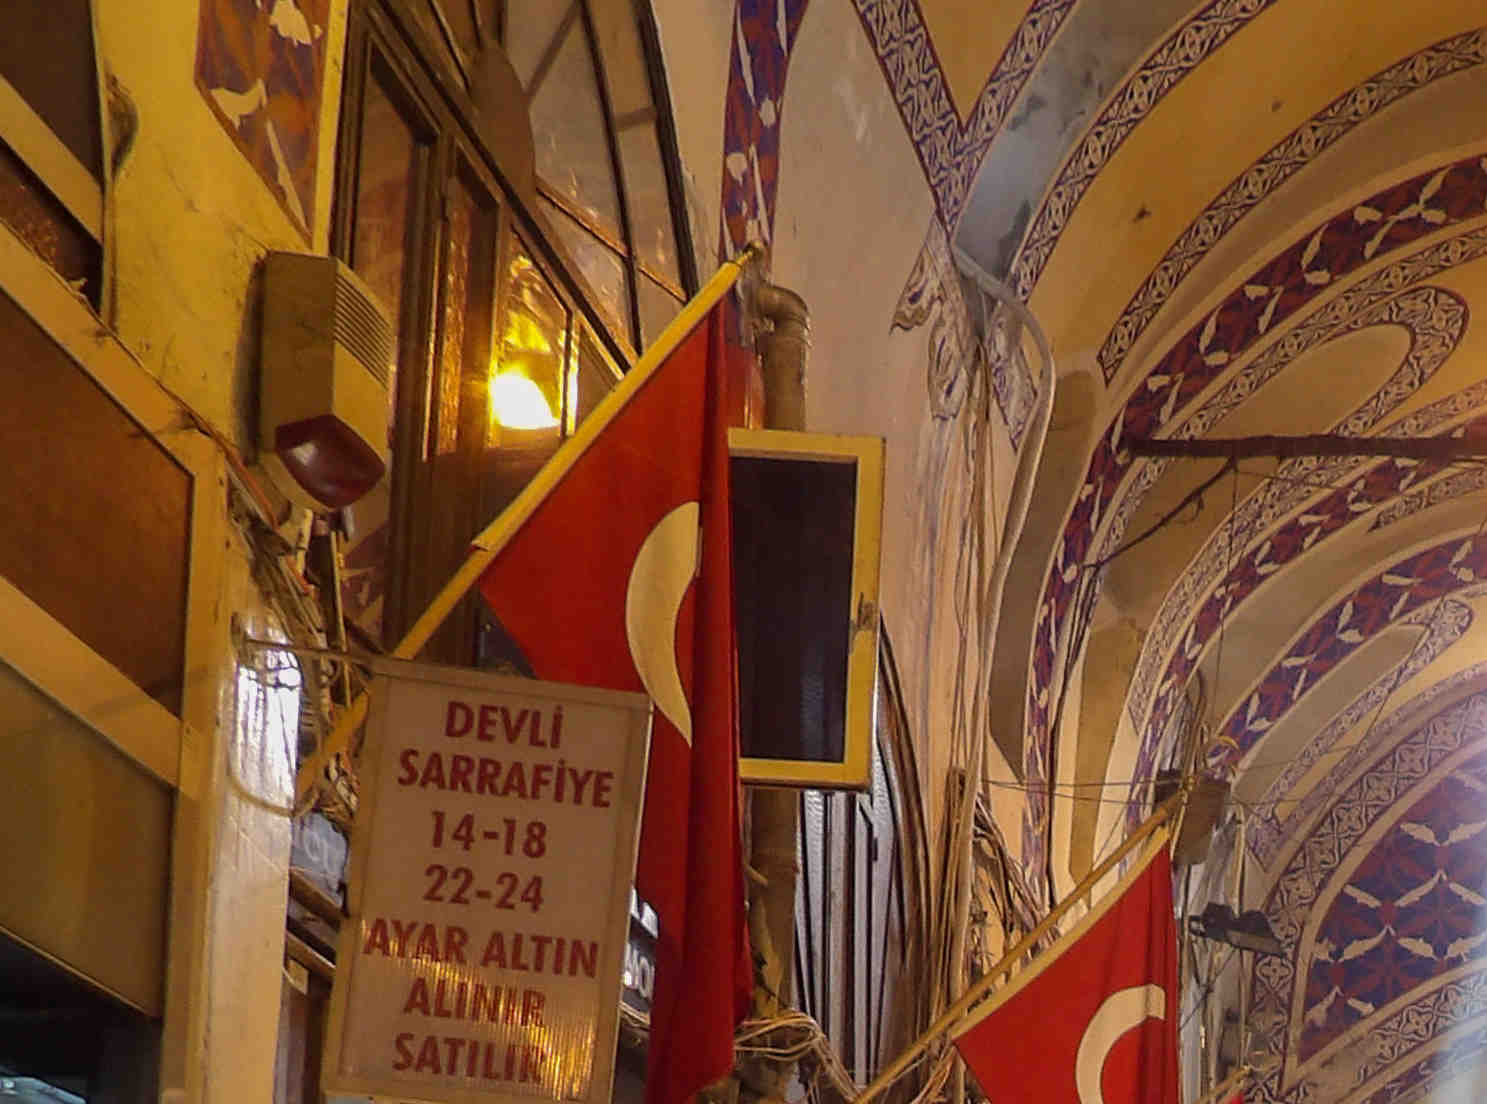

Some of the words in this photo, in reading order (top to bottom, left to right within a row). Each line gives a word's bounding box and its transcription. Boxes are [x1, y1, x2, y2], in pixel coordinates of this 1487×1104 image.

[445, 700, 564, 749] DEVLİ
[398, 749, 615, 808] SARRAFİYE
[431, 810, 548, 859] 14-18
[423, 864, 544, 912] 22-24
[363, 917, 468, 964] AYAR
[481, 931, 599, 979] ALTIN
[403, 977, 547, 1028] ALINIR
[392, 1032, 544, 1084] SATILIR
